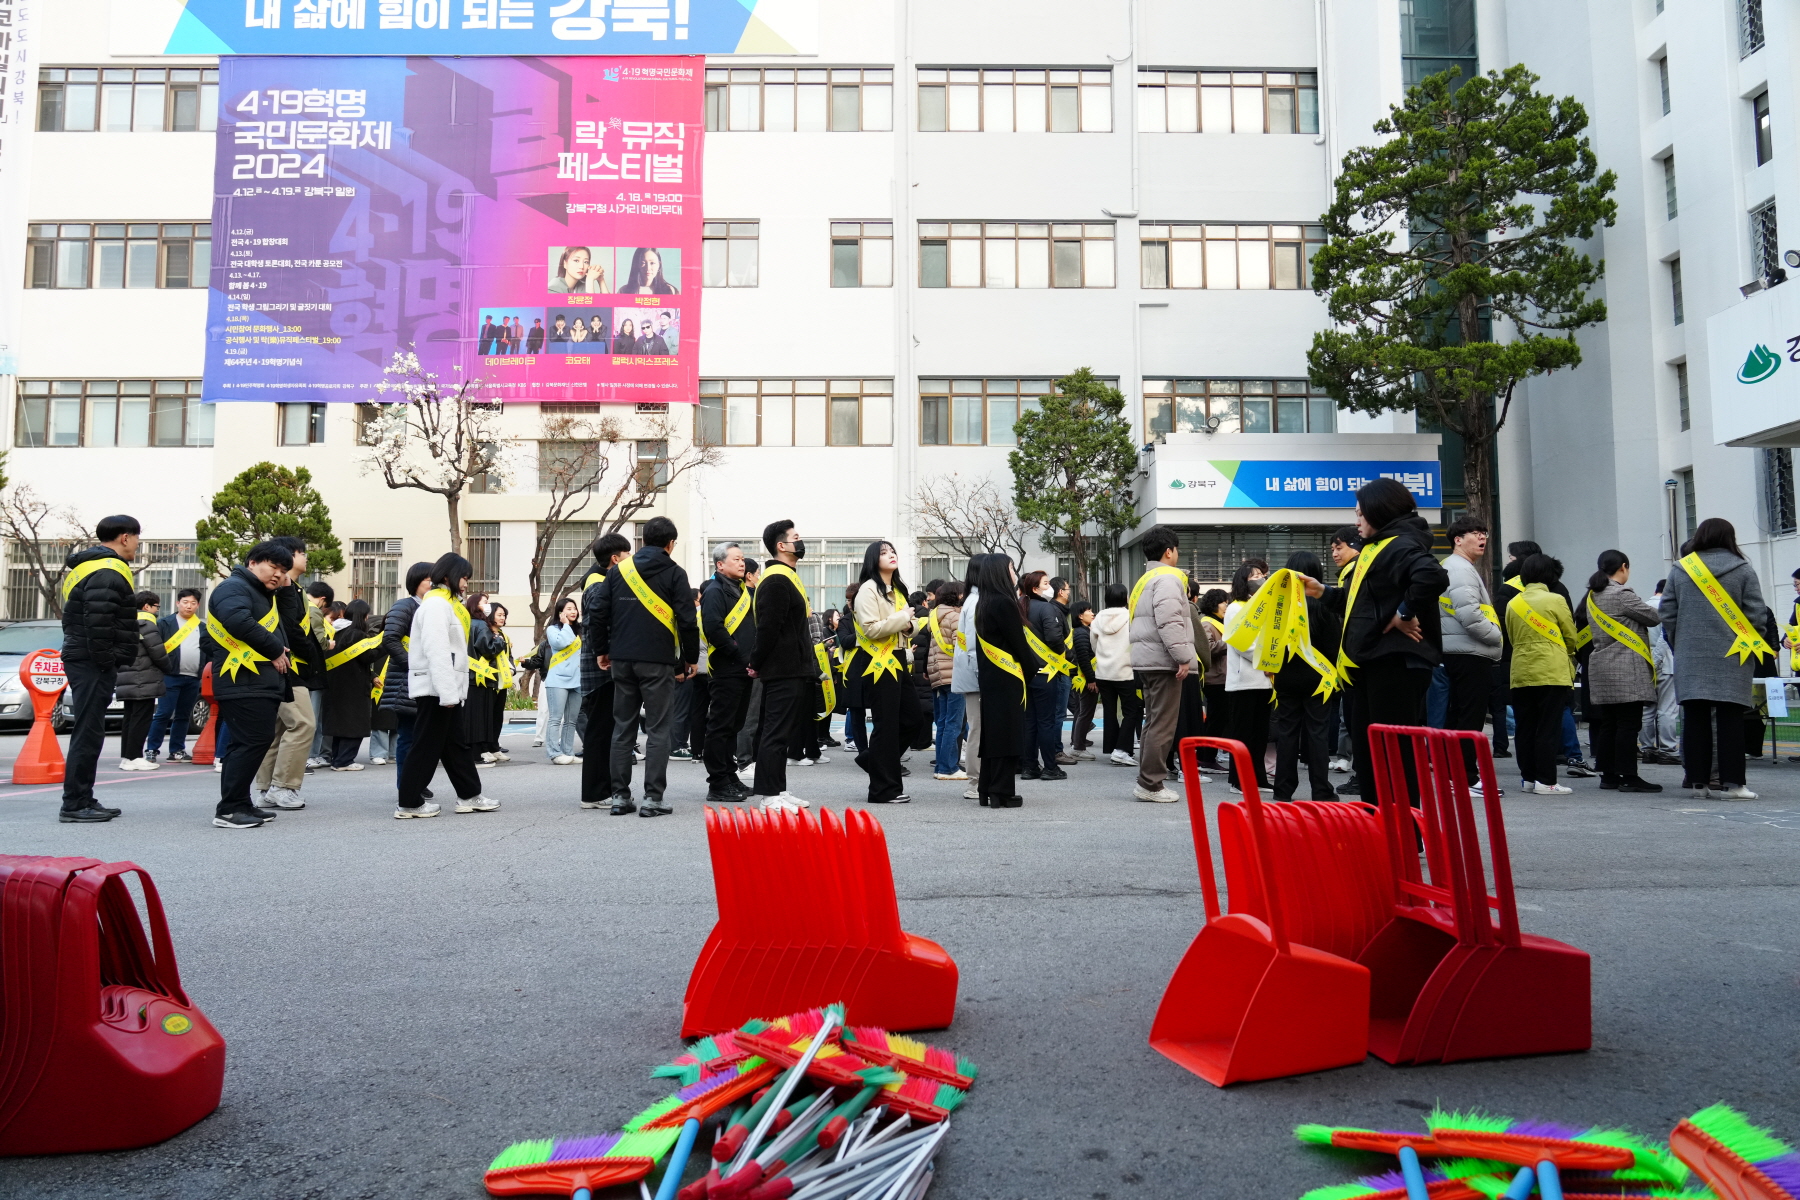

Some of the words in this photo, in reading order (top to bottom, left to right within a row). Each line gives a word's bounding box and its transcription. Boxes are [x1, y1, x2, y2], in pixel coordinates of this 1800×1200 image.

[245, 0, 281, 29] 내
[294, 0, 365, 29] 삶에
[379, 0, 449, 29] 힘이
[462, 0, 534, 29] 되는
[642, 68, 693, 77] 혁명국민문화제
[236, 88, 366, 118] 4·19혁명
[234, 120, 392, 150] 국민문화제
[622, 121, 685, 151] 뮤직
[232, 154, 325, 180] 2024
[557, 153, 683, 183] 페스티벌
[304, 187, 334, 197] 강북구
[335, 187, 355, 197] 일원
[653, 193, 683, 202] 19:00
[566, 204, 606, 214] 강북구청
[607, 204, 639, 214] 사거리
[642, 205, 683, 215] 메인무대
[230, 260, 244, 268] 전국
[244, 260, 264, 268] 대학생
[294, 260, 308, 268] 전국
[228, 282, 242, 290] 함께
[567, 296, 593, 304] 장윤정
[635, 297, 660, 305] 박정현
[241, 303, 254, 311] 학생
[256, 303, 288, 311] 그림그리기
[290, 303, 296, 311] 및
[297, 303, 317, 311] 글짓기
[318, 303, 332, 311] 대회
[225, 325, 251, 333] 시민참여
[225, 336, 252, 344] 공식행사
[224, 358, 252, 366] 제64주년
[485, 357, 535, 366] 데이브레이크
[565, 357, 590, 365] 코요태
[612, 357, 679, 366] 갤럭시익스프레스
[1188, 480, 1216, 488] 강북구
[1265, 477, 1280, 491] 내
[1284, 477, 1311, 491] 삶에
[1316, 477, 1343, 491] 힘이
[1380, 473, 1432, 496] 북!
[35, 677, 63, 685] 강북구청
